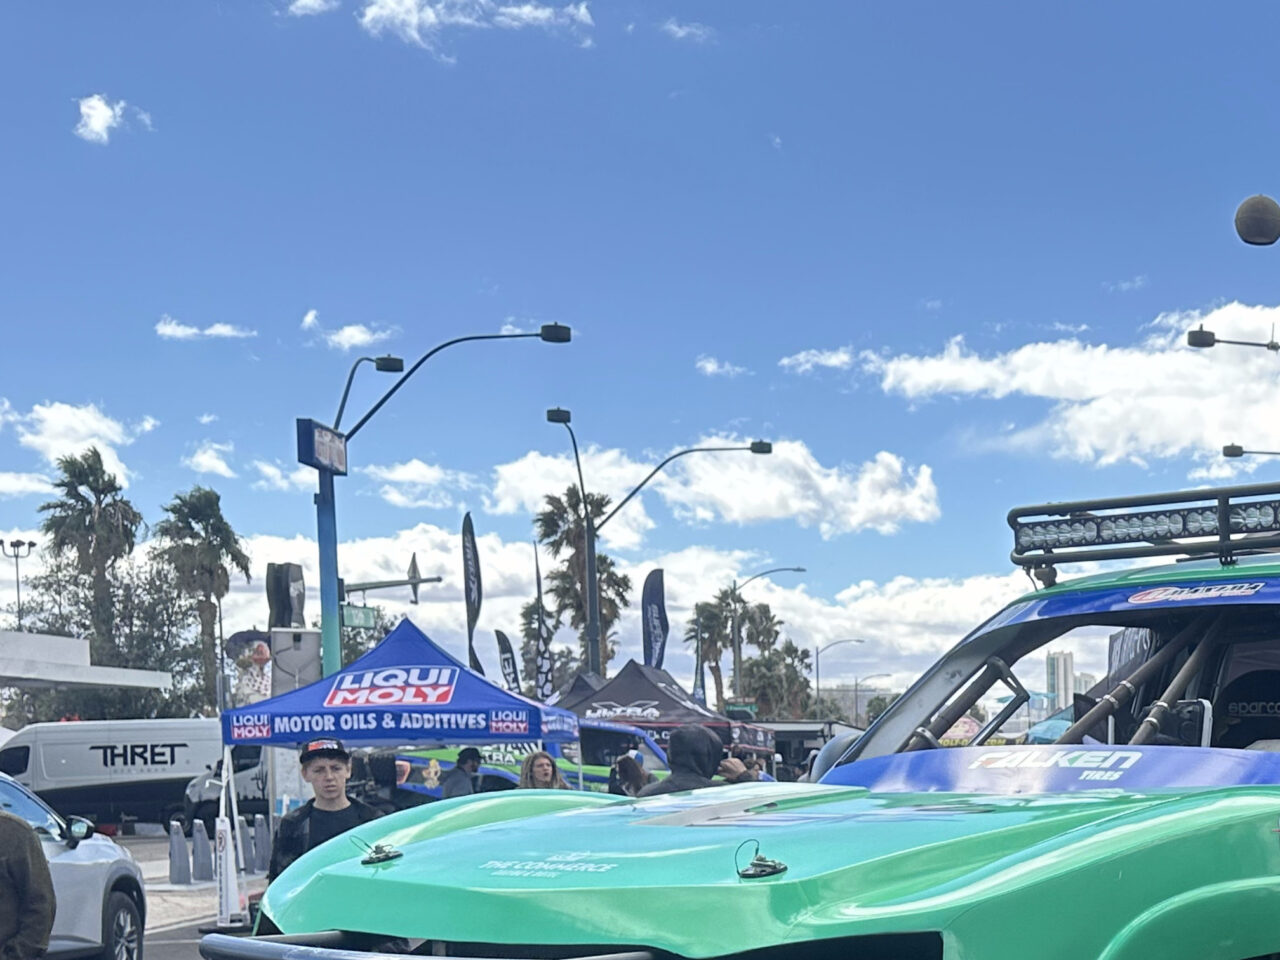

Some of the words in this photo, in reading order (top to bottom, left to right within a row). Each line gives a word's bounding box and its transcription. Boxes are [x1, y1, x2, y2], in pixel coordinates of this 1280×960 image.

[340, 668, 452, 690] LIQUI
[332, 686, 451, 705] MOLY
[232, 714, 268, 726] LIQUI
[274, 715, 335, 733] MOTOR
[340, 713, 377, 731] OILS
[382, 712, 395, 726] &
[400, 712, 487, 730] ADDITIVES
[491, 710, 527, 721] LIQUI
[233, 726, 270, 738] MOLY
[490, 721, 528, 733] MOLY
[89, 743, 188, 768] THRET
[968, 750, 1143, 770] FALKEN
[1078, 770, 1124, 781] TIRES
